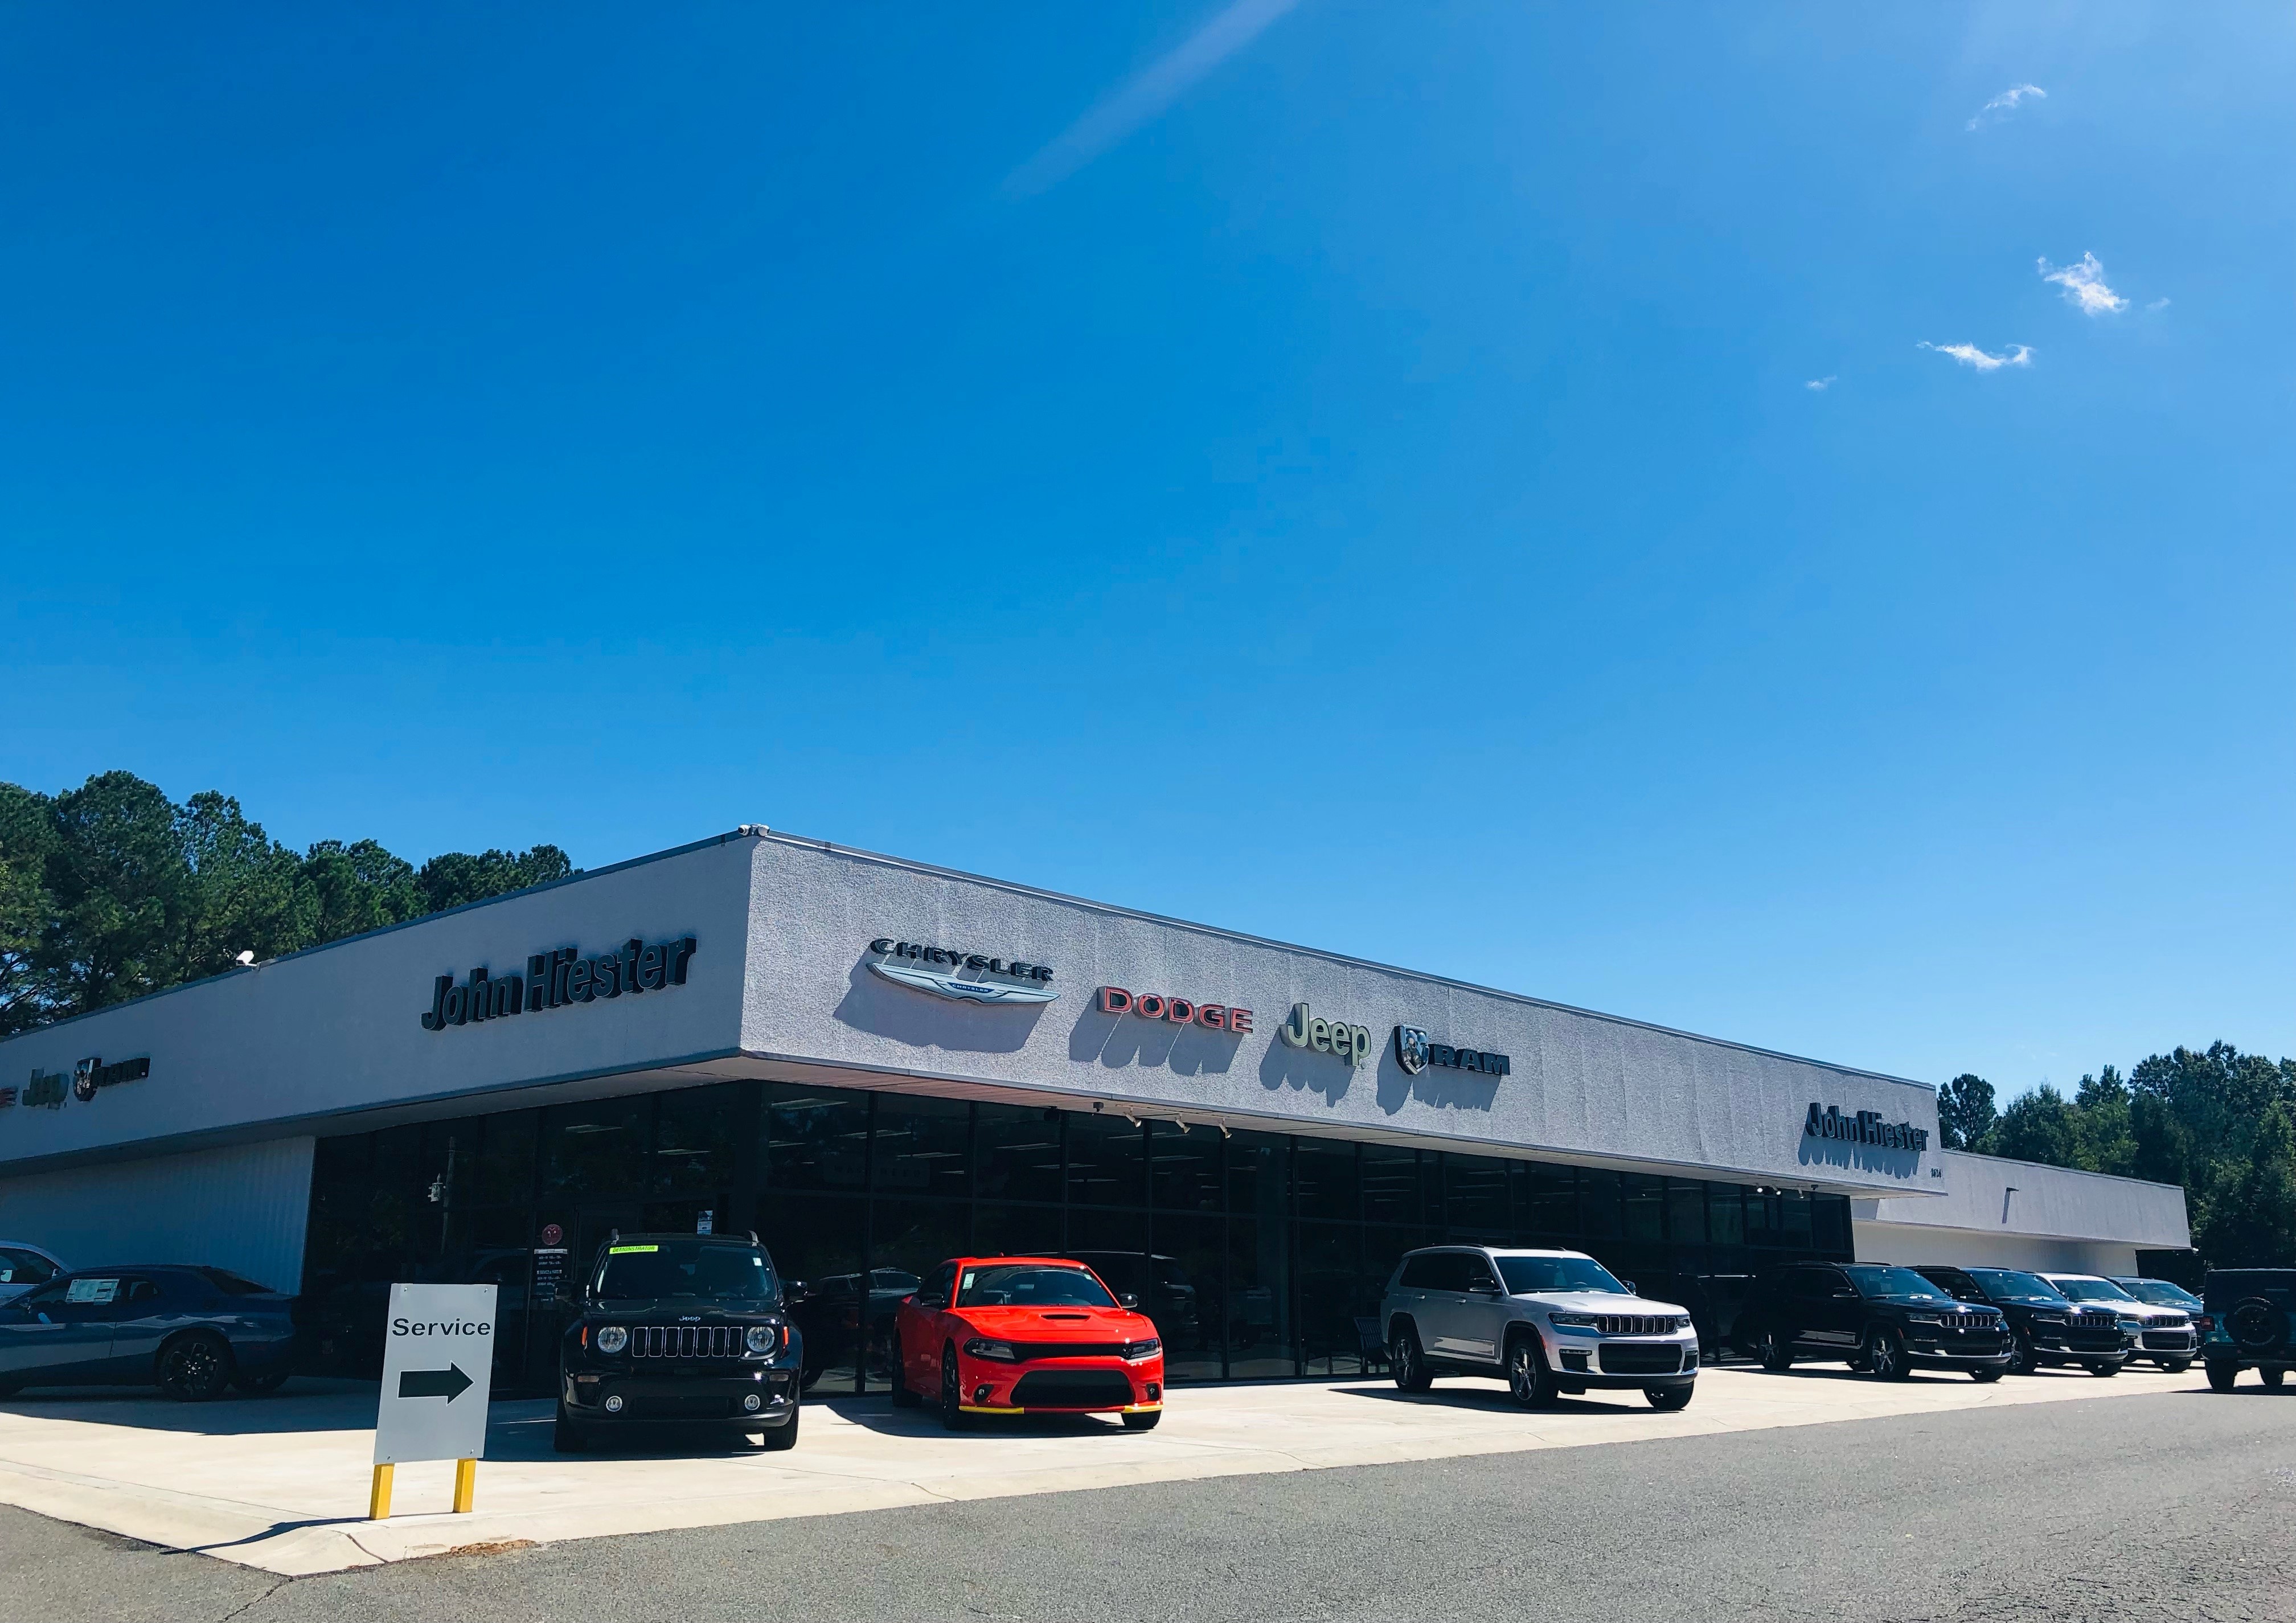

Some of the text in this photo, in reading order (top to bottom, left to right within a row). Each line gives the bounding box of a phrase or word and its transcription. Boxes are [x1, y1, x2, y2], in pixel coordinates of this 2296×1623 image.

[869, 938, 1054, 981] CHRYSLER
[421, 937, 697, 1031] John Hiester
[1097, 986, 1253, 1033] DODGE
[1280, 1002, 1371, 1067] Jeep
[1428, 1043, 1510, 1075] RAM
[1805, 1103, 1929, 1151] John Hiester
[392, 1318, 491, 1336] Service
